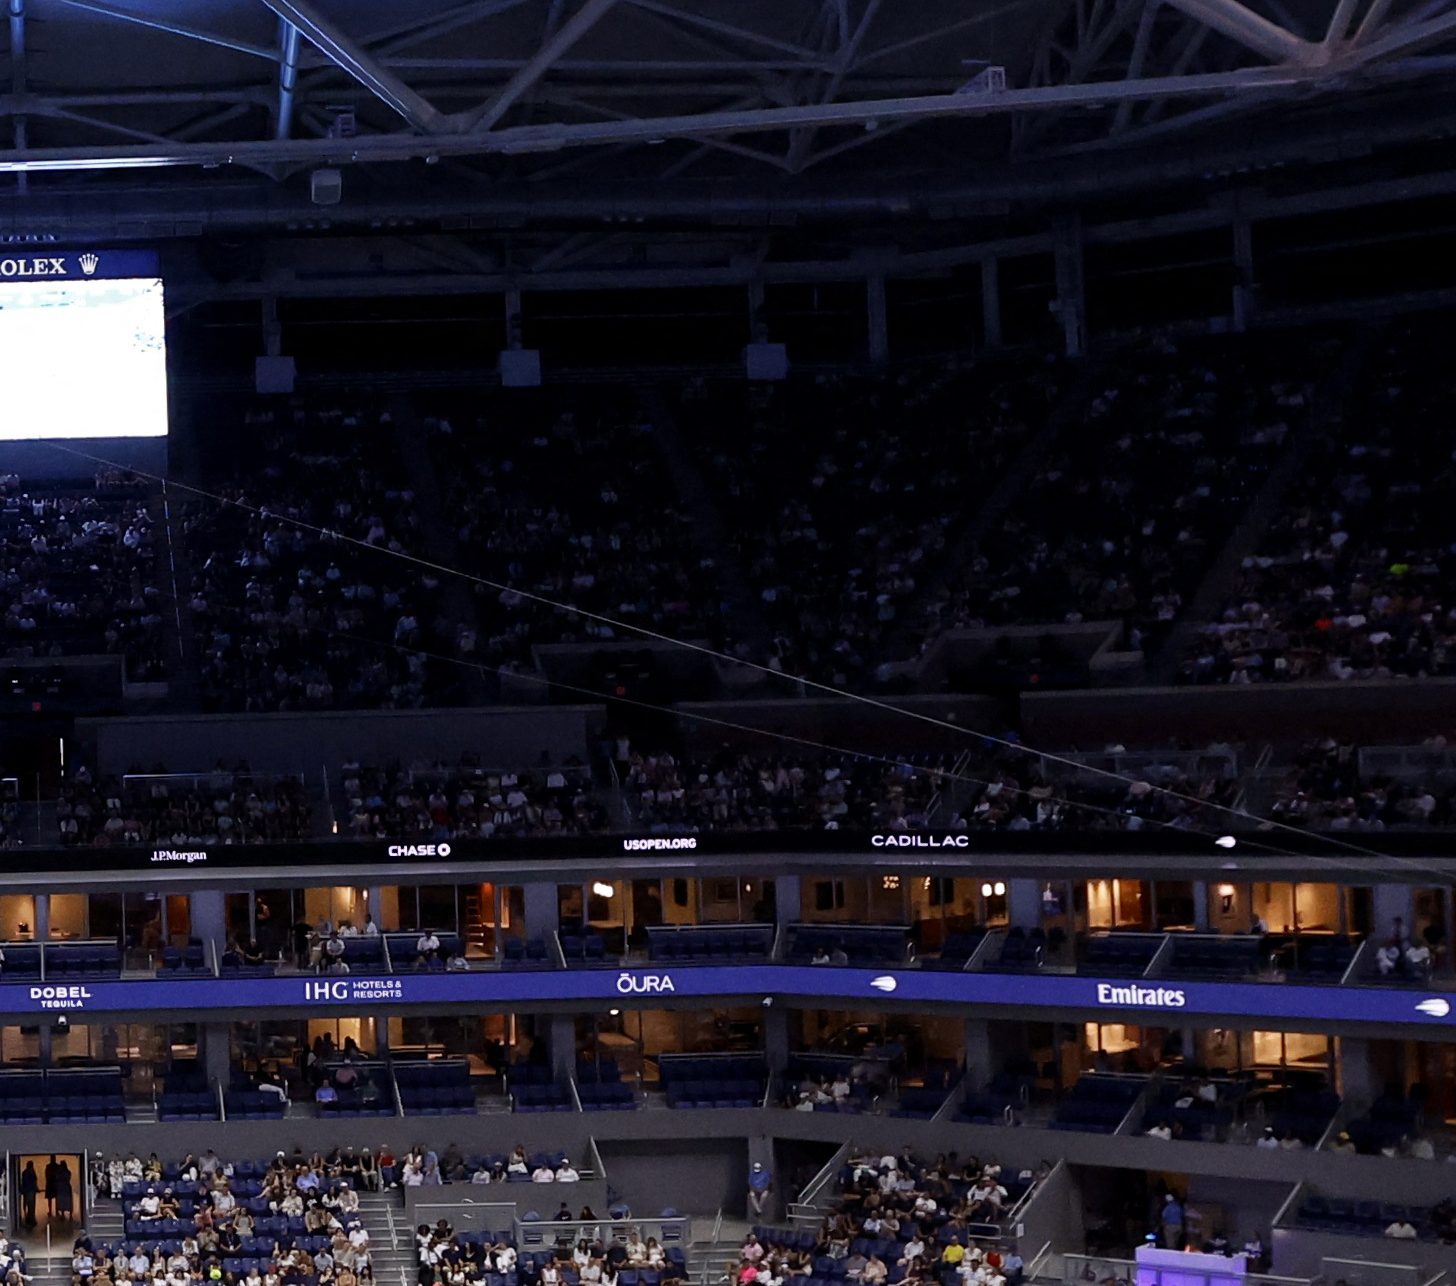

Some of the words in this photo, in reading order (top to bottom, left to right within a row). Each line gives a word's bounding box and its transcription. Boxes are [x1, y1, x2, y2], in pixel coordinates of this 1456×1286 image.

[624, 838, 696, 850] USOPEN.ORG
[872, 835, 968, 847] CADILLAC
[389, 845, 436, 856] CHASE
[151, 851, 206, 862] J.P.Morgan
[353, 981, 393, 989] HOTELS
[617, 973, 674, 992] ŌURA
[31, 987, 91, 998] DOBEL
[306, 982, 348, 999] IHG
[354, 990, 402, 998] RESORTS
[1098, 984, 1185, 1006] Emirates
